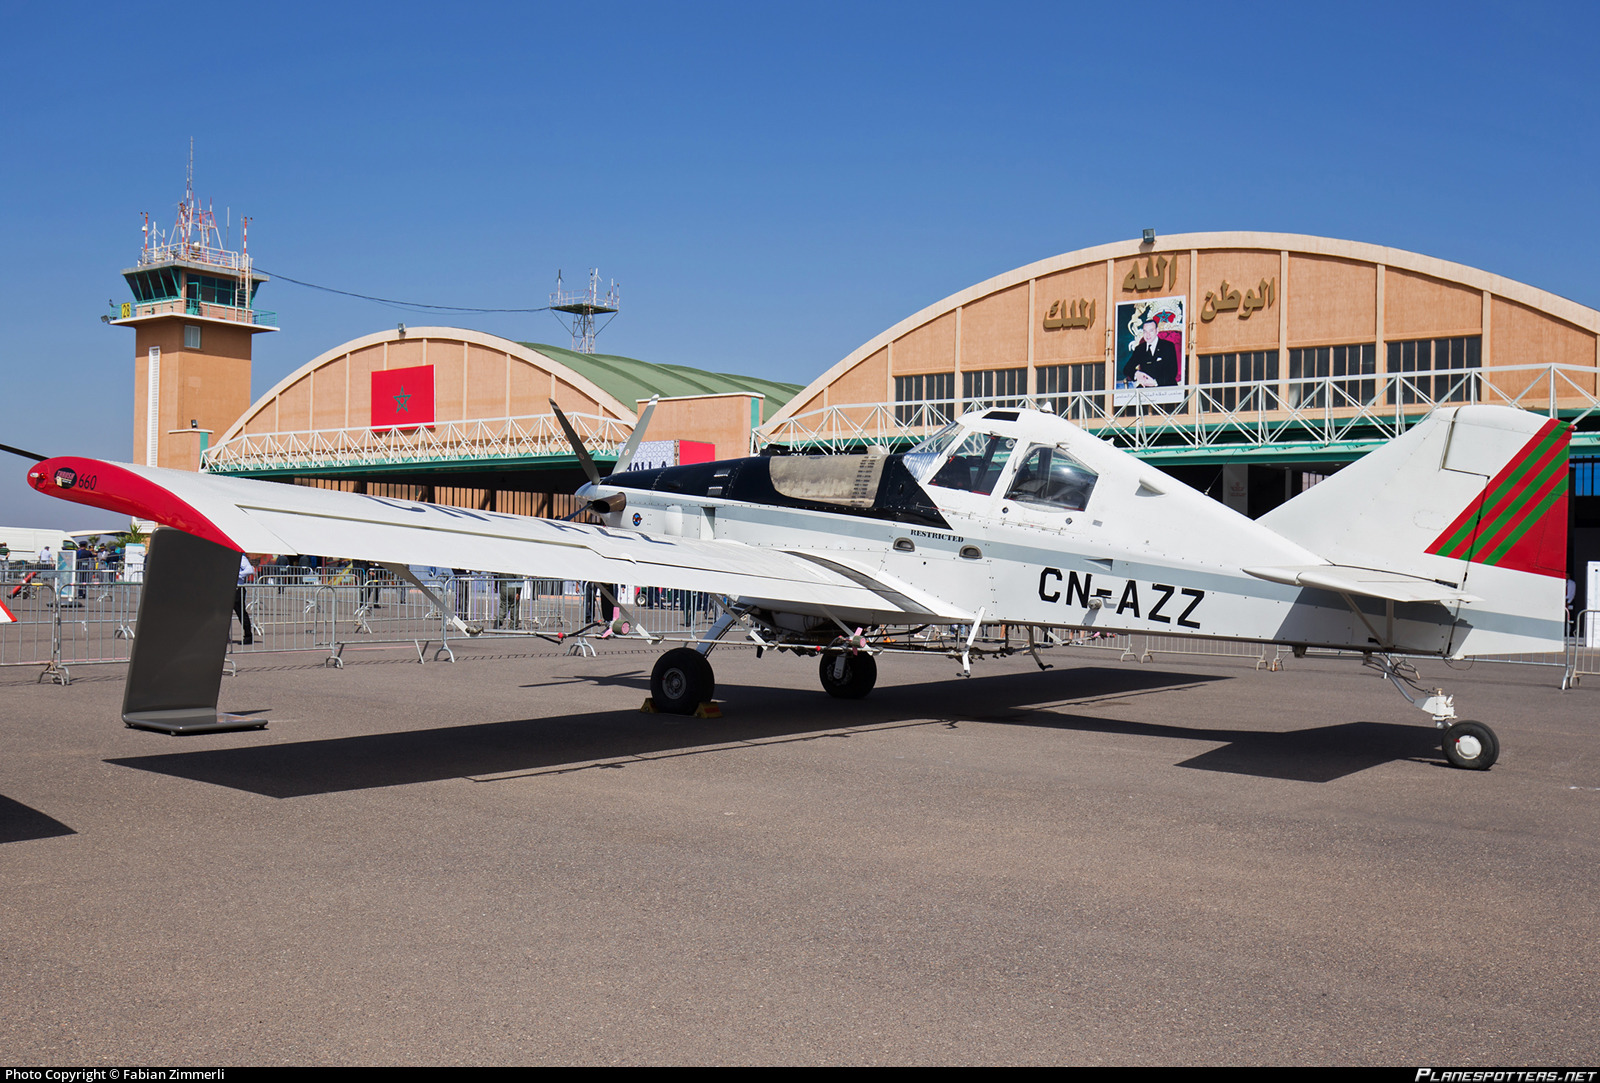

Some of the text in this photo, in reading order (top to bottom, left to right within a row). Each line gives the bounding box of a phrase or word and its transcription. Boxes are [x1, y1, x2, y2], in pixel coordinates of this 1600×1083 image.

[1122, 253, 1178, 291] الله
[1043, 298, 1096, 329] الملك
[1201, 277, 1276, 321] الوطن
[78, 473, 97, 490] 660
[910, 528, 964, 543] RESTRICTED
[1038, 567, 1205, 629] CN-AZZ
